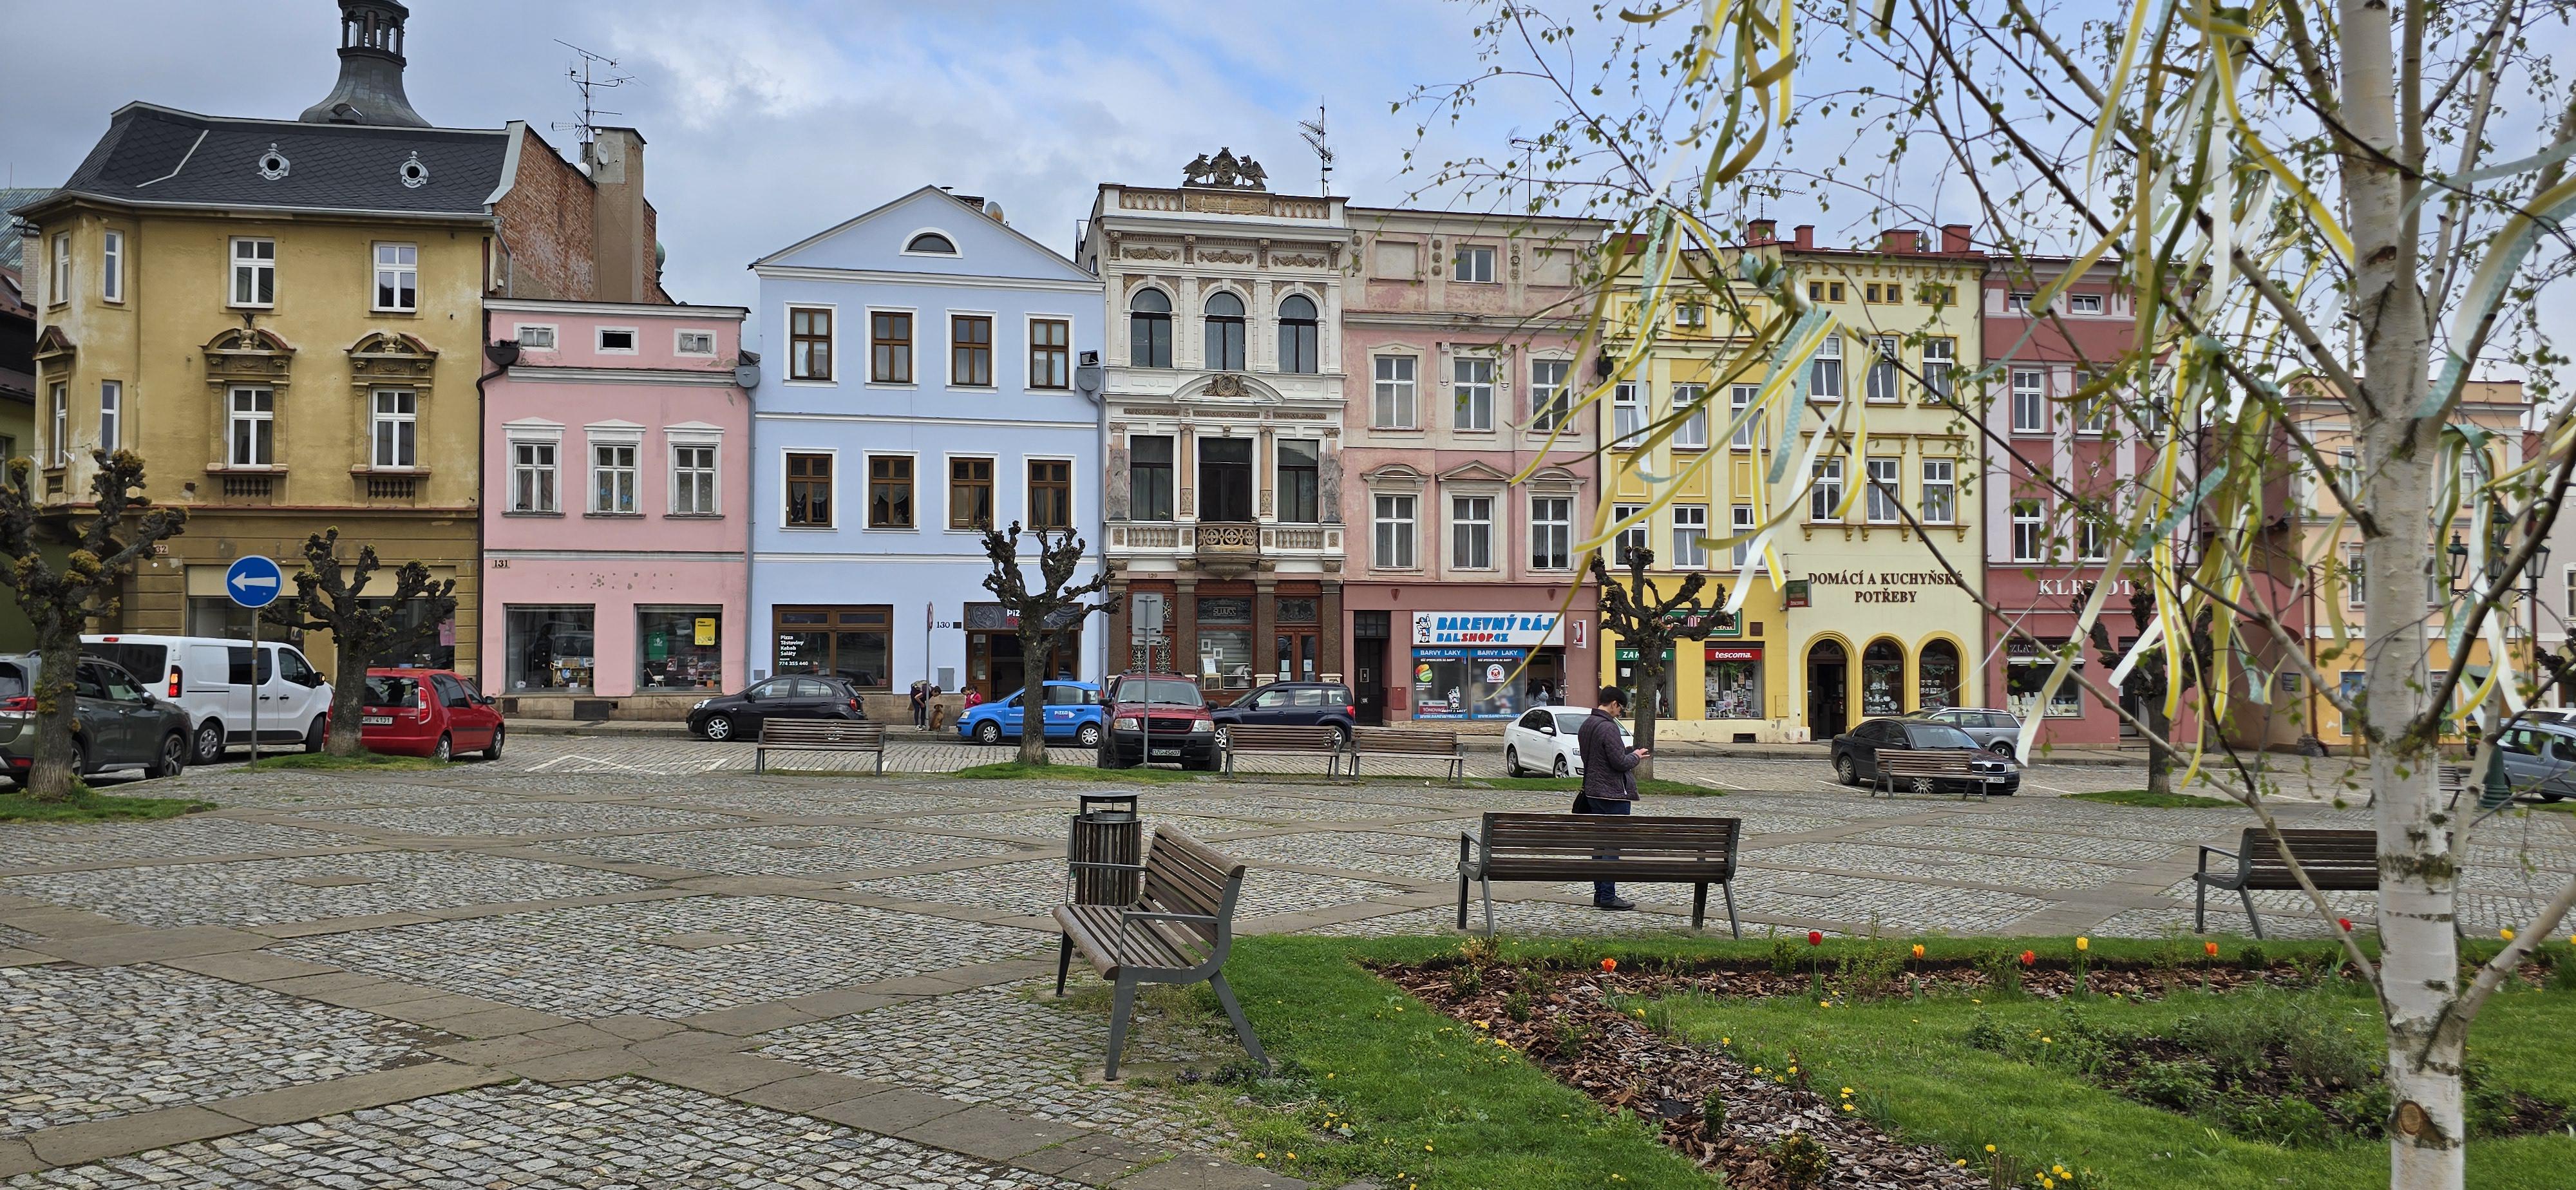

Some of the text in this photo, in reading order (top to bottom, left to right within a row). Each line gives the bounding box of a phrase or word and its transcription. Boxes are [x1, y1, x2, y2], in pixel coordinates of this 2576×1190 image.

[1808, 569, 1864, 585] DOMÁCÍ
[1867, 572, 1877, 585] A
[1855, 587, 1917, 603] POTŘEBY
[1436, 614, 1556, 630] BAREVNÝ RÁJ
[1436, 633, 1509, 642] BALSHOP.CZ
